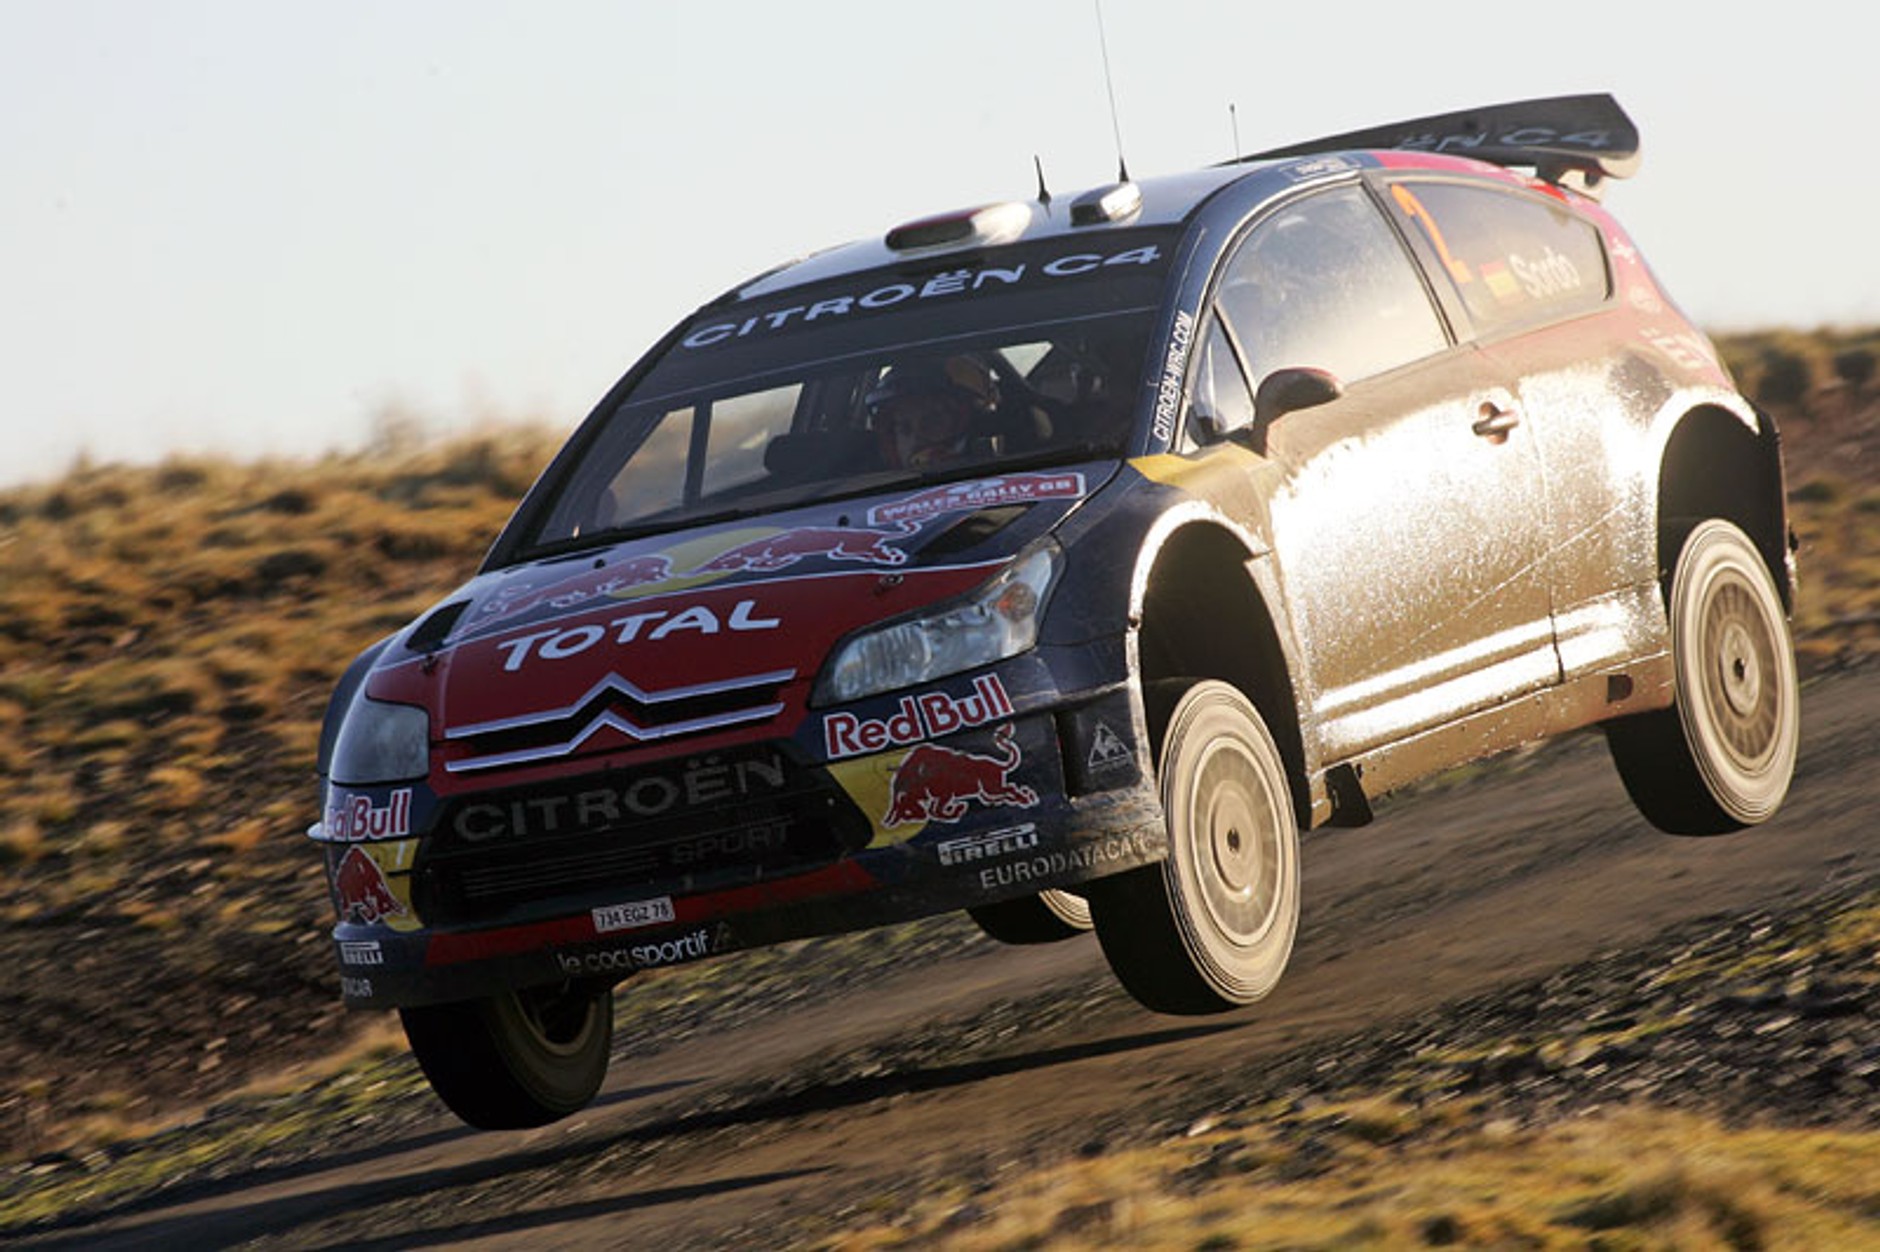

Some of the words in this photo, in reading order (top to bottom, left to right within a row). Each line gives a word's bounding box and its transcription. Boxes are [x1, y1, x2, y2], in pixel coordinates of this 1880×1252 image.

[1501, 126, 1612, 147] C4
[682, 264, 1027, 349] CITROËN
[1042, 244, 1162, 277] C4
[1038, 478, 1072, 492] GB
[497, 600, 780, 671] TOTAL
[825, 696, 926, 760] Red
[916, 671, 1016, 739] Bull
[348, 786, 412, 842] Bull
[452, 754, 785, 842] CITROËN
[937, 822, 1039, 866] PIRELLI
[979, 832, 1147, 889] EURODATACAR
[556, 952, 582, 974] le
[631, 928, 710, 968] sportif
